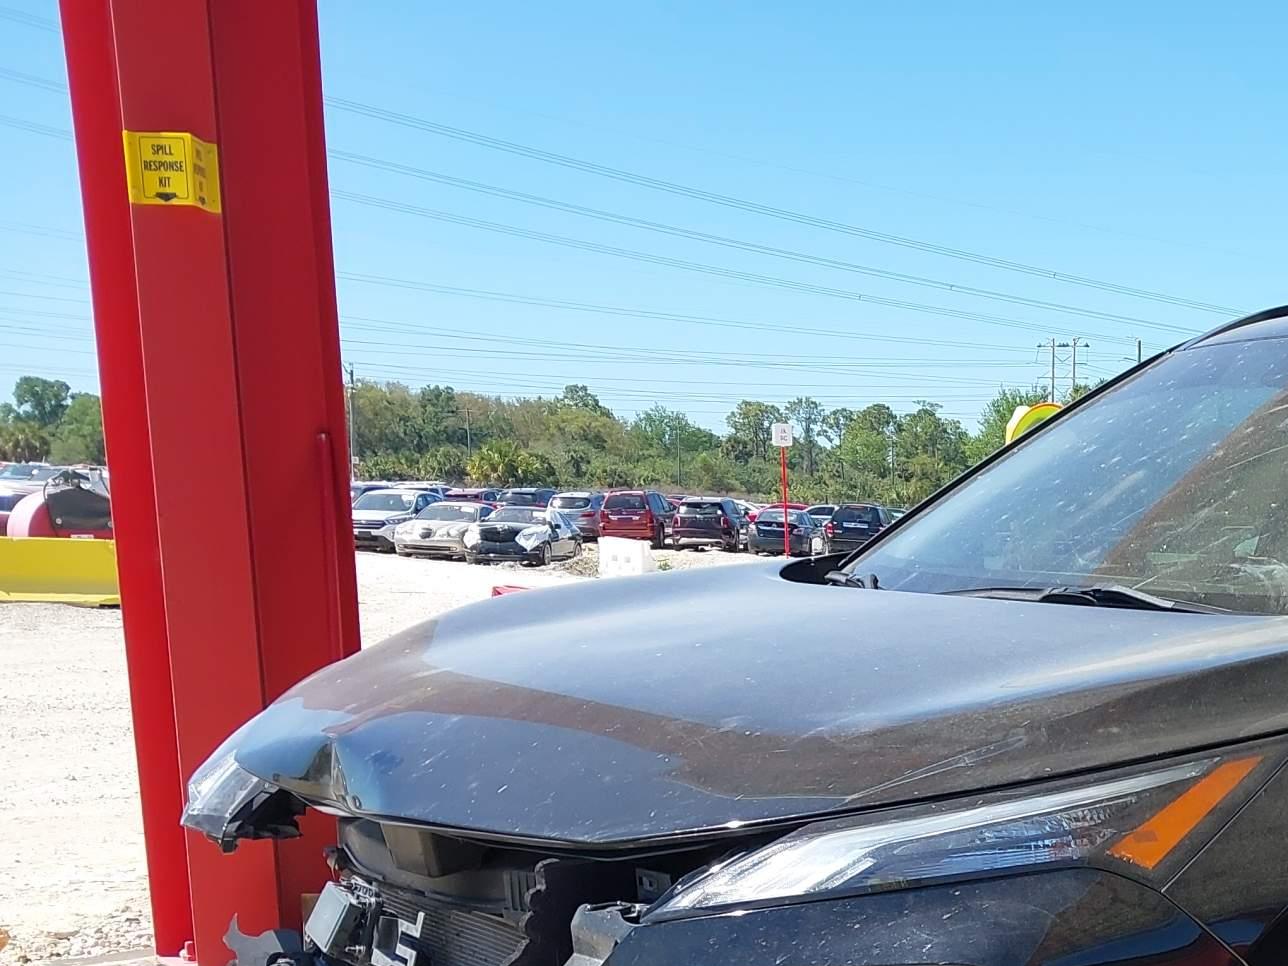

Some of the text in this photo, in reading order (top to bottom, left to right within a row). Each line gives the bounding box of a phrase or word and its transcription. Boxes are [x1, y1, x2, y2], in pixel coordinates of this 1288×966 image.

[151, 144, 173, 155] SPILL
[143, 160, 184, 172] RESPONSE
[158, 177, 171, 187] KIT
